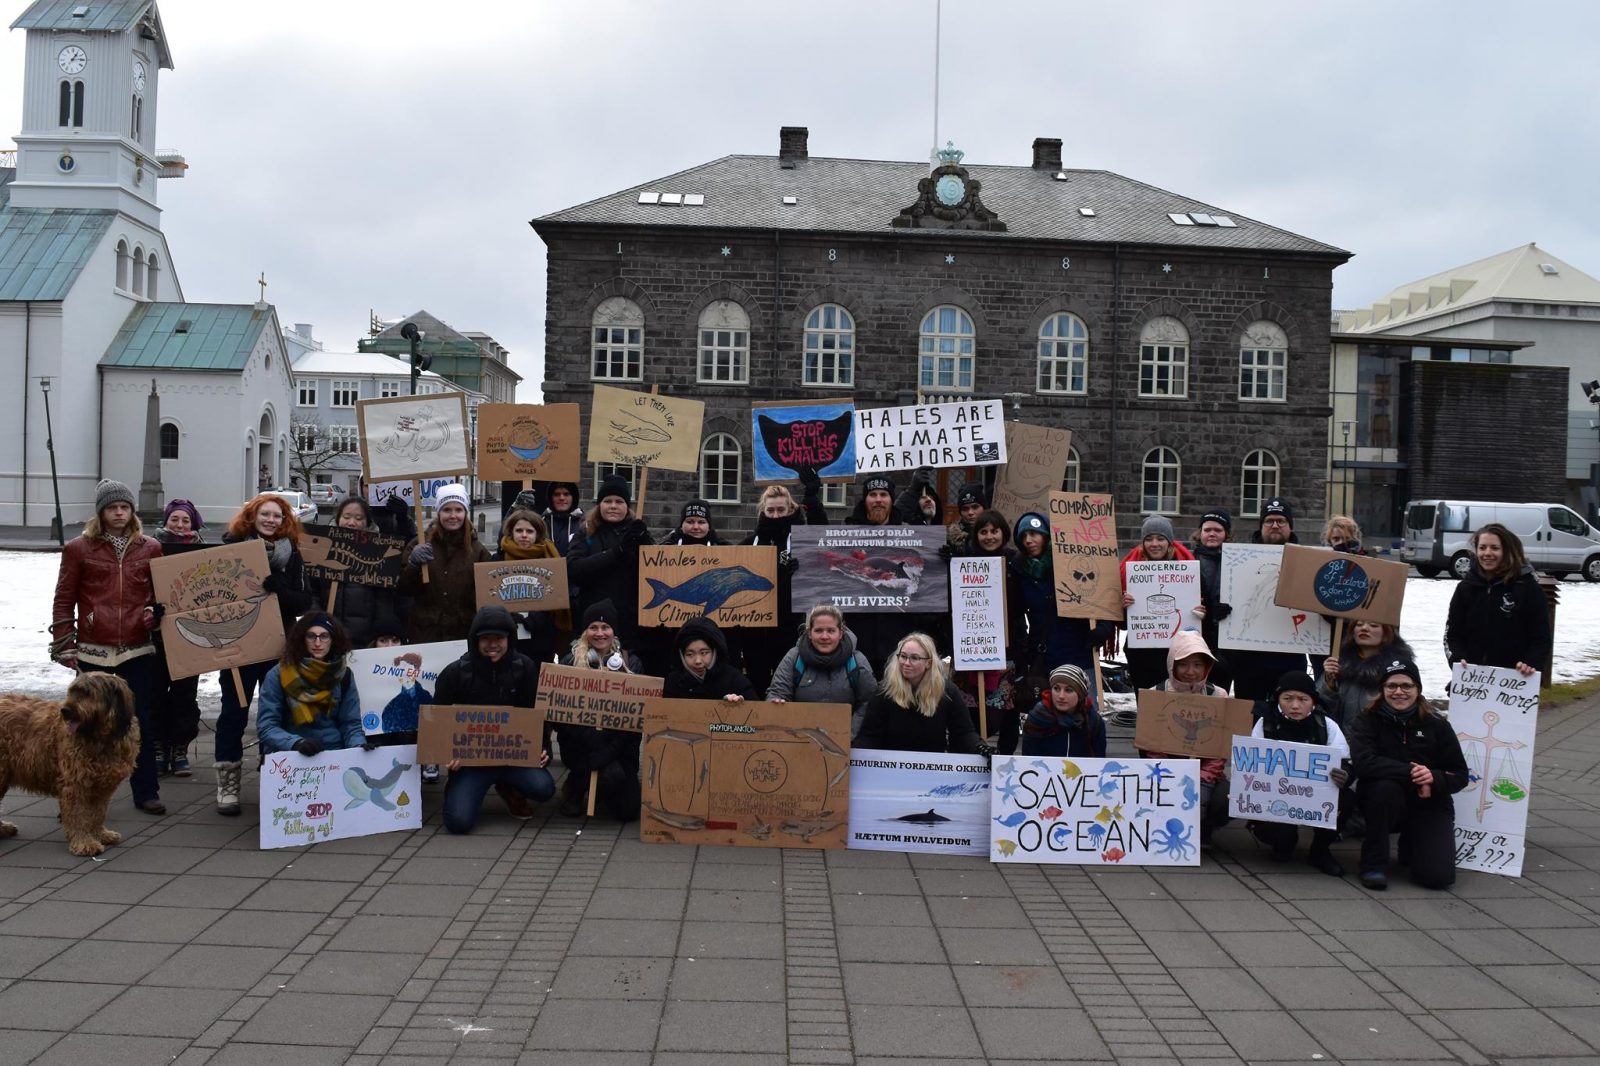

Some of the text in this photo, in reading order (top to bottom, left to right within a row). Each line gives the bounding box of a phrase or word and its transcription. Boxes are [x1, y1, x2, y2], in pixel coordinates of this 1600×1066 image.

[828, 248, 837, 261] 8
[1062, 257, 1070, 270] 8
[634, 397, 674, 427] LET THEM LIVE
[860, 405, 995, 429] HALES ARE
[791, 421, 825, 438] STOP
[864, 424, 984, 450] CLIMATE
[777, 434, 838, 452] KILLING
[779, 448, 834, 464] WHALES
[375, 484, 398, 502] LIST
[402, 487, 413, 497] OF
[1050, 495, 1114, 520] COMPASSION
[825, 528, 915, 537] HROTTALEG DRÁP
[1055, 517, 1109, 544] IS NOT
[818, 538, 923, 547] Á SAKLAUSUM DÝRUM
[1054, 543, 1119, 557] TERRORISM
[642, 550, 720, 567] Whales are
[1133, 563, 1188, 572] CONCERNED
[189, 577, 211, 594] MORE
[1129, 574, 1195, 584] ABOUT MERCURY
[1323, 571, 1338, 583] of
[193, 589, 238, 607] MORE FISH
[499, 583, 544, 601] WHALES
[961, 590, 985, 599] FLEIRI
[831, 596, 911, 607] TIL HVERS?
[965, 600, 990, 608] HVALIR
[719, 607, 773, 623] Warriors
[961, 612, 987, 621] FLEIRI
[966, 621, 995, 630] FISKAR
[1131, 622, 1155, 630] UNLESS
[1136, 632, 1150, 640] EAT
[372, 664, 438, 681] DO NOT EAT WHA
[1461, 668, 1527, 691] Which one
[582, 678, 610, 695] WHALE
[588, 697, 637, 714] WATCHING
[1496, 691, 1540, 714] more?
[455, 711, 510, 723] HVALIR
[546, 708, 645, 729] WITH 125 PEOPLE
[1180, 709, 1208, 720] SAVE
[709, 723, 756, 733] PHYTOPLANKTON
[747, 766, 781, 776] WHALE
[755, 759, 774, 768] THE
[899, 762, 953, 772] FORDÆMIR
[1233, 746, 1331, 782] WHALE
[752, 774, 779, 783] PUMP
[1243, 774, 1314, 798] You Save
[1014, 770, 1176, 810] SAVE THE
[305, 802, 333, 818] STOP
[1236, 793, 1262, 814] the
[855, 832, 902, 843] HÆTTUM
[1017, 819, 1150, 853] OCEAN
[1454, 827, 1508, 847] oney or
